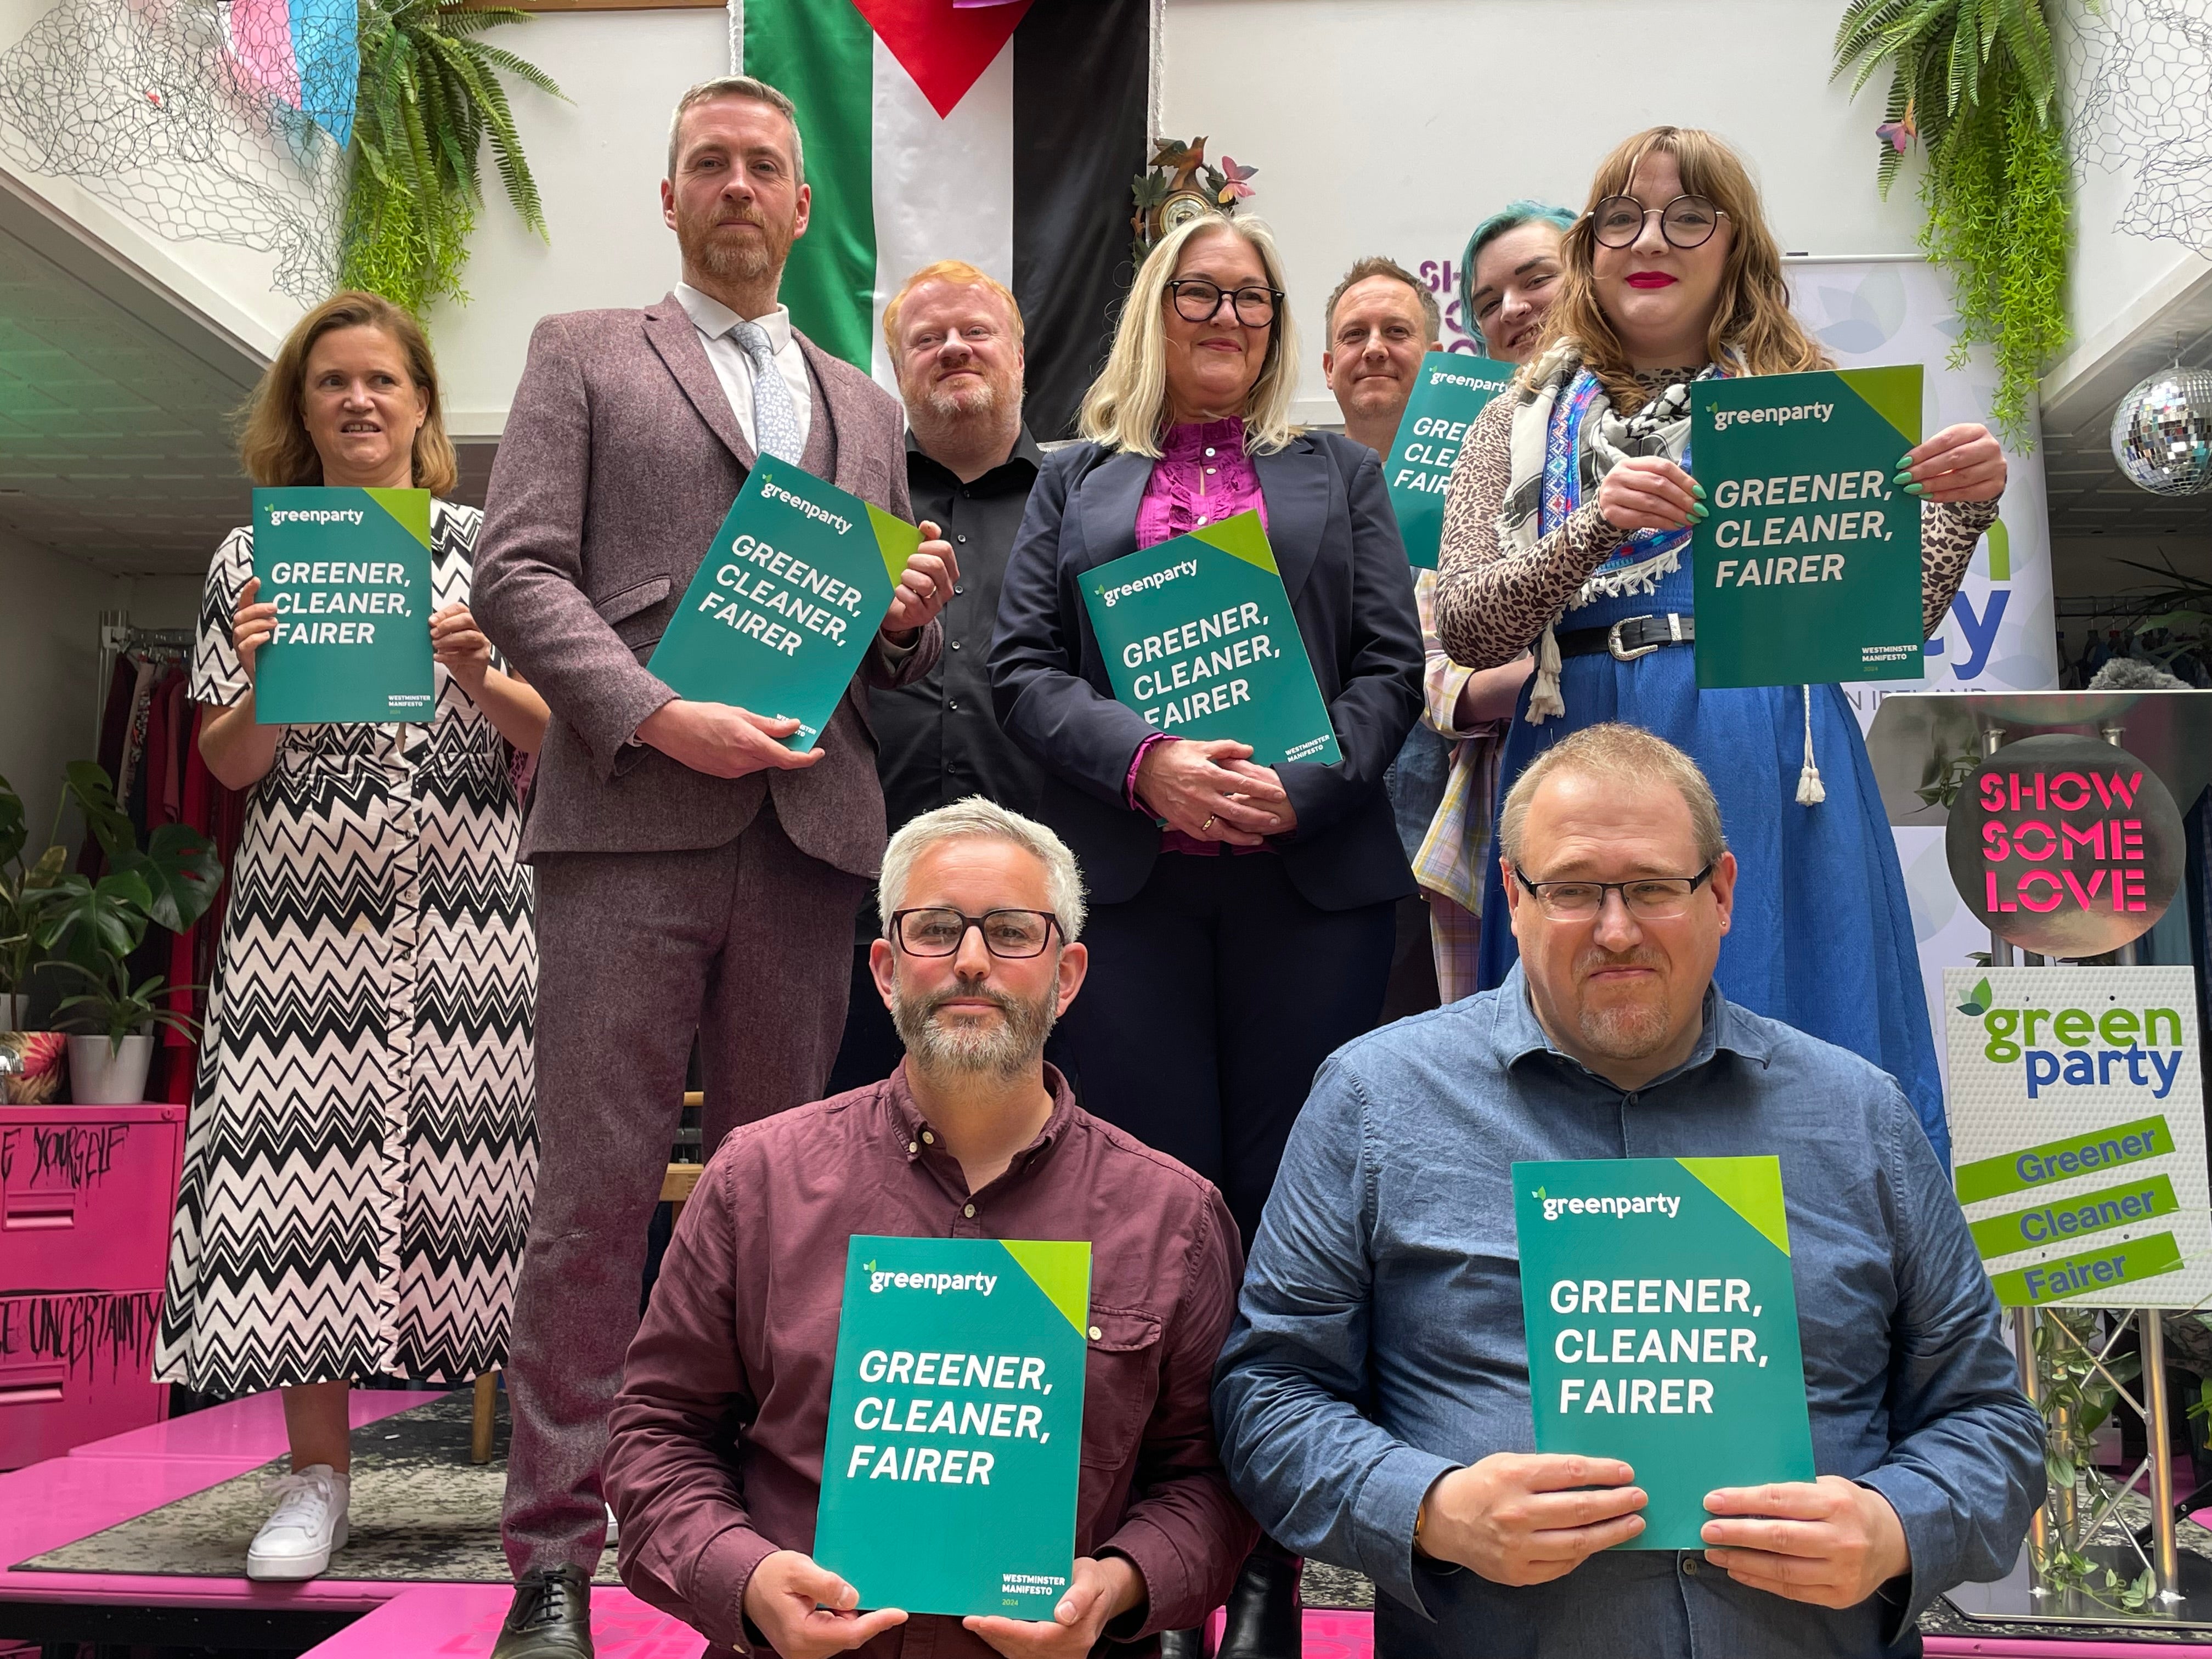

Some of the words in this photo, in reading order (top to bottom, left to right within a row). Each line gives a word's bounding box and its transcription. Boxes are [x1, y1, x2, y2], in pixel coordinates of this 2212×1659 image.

[1413, 417, 1471, 442] GRE
[1714, 401, 1835, 431] greenparty
[1404, 443, 1456, 469] CLE
[761, 482, 853, 535] greenparty
[1715, 470, 1892, 509] GREENER,
[271, 509, 364, 526] greenparty
[1715, 511, 1893, 548] CLEANER,
[272, 562, 411, 587] GREENER,
[732, 534, 862, 617] GREENER,
[1103, 559, 1198, 607] greenparty
[1715, 554, 1846, 588] FAIRER
[273, 592, 412, 617] CLEANER,
[698, 591, 803, 657] FAIRER
[716, 564, 847, 647] CLEANER,
[272, 623, 375, 644] FAIRER
[1123, 602, 1269, 668] GREENER,
[1861, 645, 1918, 654] WESTMINSTER
[1133, 635, 1280, 700] CLEANER,
[1862, 653, 1907, 662] MANIFESTO
[1143, 679, 1251, 729] FAIRER
[1285, 735, 1330, 755] WESTMINSTER
[1287, 744, 1323, 763] MANIFESTO
[1979, 771, 2143, 812] SHOW
[1982, 819, 2144, 862] SOME
[1985, 868, 2147, 913] LOVE
[1983, 1008, 2183, 1063] green
[2025, 1041, 2183, 1099] party
[2016, 1129, 2156, 1183] Greener
[1543, 1193, 1681, 1220] greenparty
[2019, 1190, 2155, 1242] Cleaner
[870, 1271, 997, 1296] greenparty
[2024, 1255, 2126, 1300] Fairer
[1550, 1279, 1762, 1317] GREENER,
[29, 1291, 164, 1368] UNCERTAINTY
[1554, 1328, 1768, 1368] CLEANER,
[859, 1350, 1053, 1396] GREENER,
[1559, 1379, 1714, 1414] FAIRER
[854, 1397, 1051, 1444] CLEANER,
[847, 1445, 995, 1485] FAIRER
[1002, 1573, 1065, 1586] WESTMINSTER
[1002, 1584, 1053, 1595] MANIFESTO
